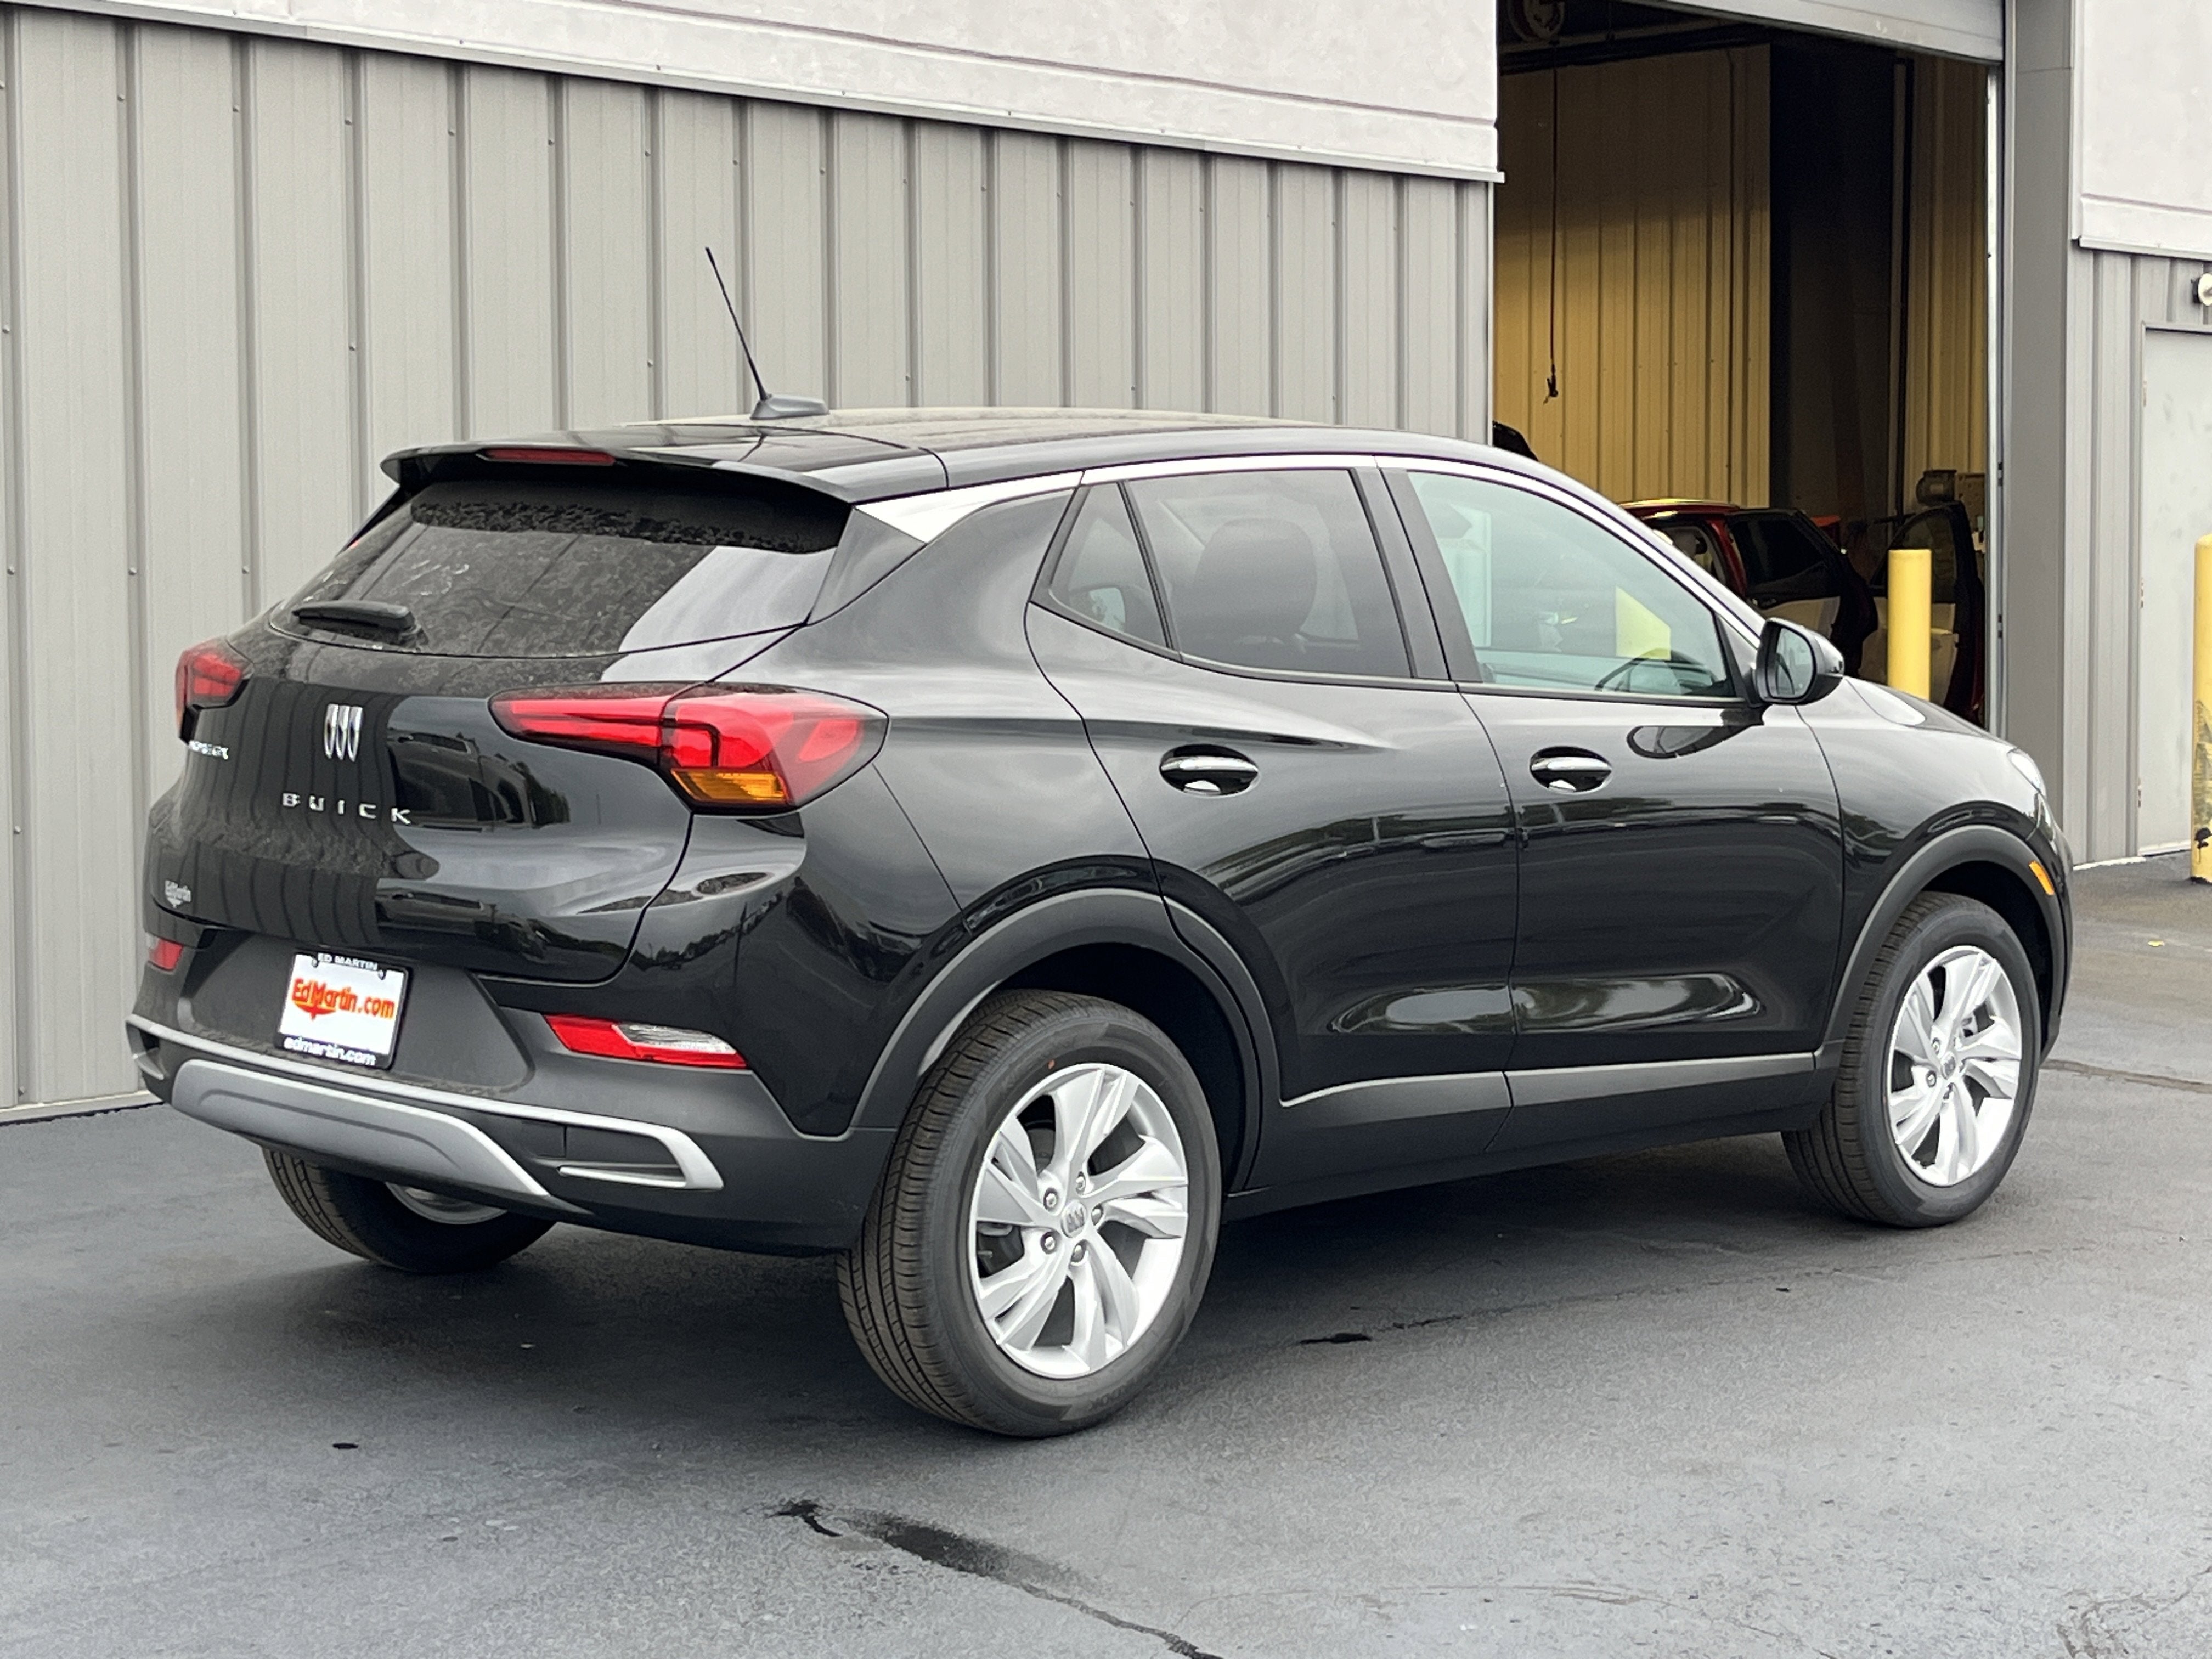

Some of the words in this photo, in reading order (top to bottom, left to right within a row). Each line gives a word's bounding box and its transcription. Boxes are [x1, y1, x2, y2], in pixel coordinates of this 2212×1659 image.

[283, 793, 411, 825] BUICK
[318, 952, 332, 963] ED
[334, 956, 378, 970] MARTIN
[284, 1036, 376, 1066] edmartin.com
